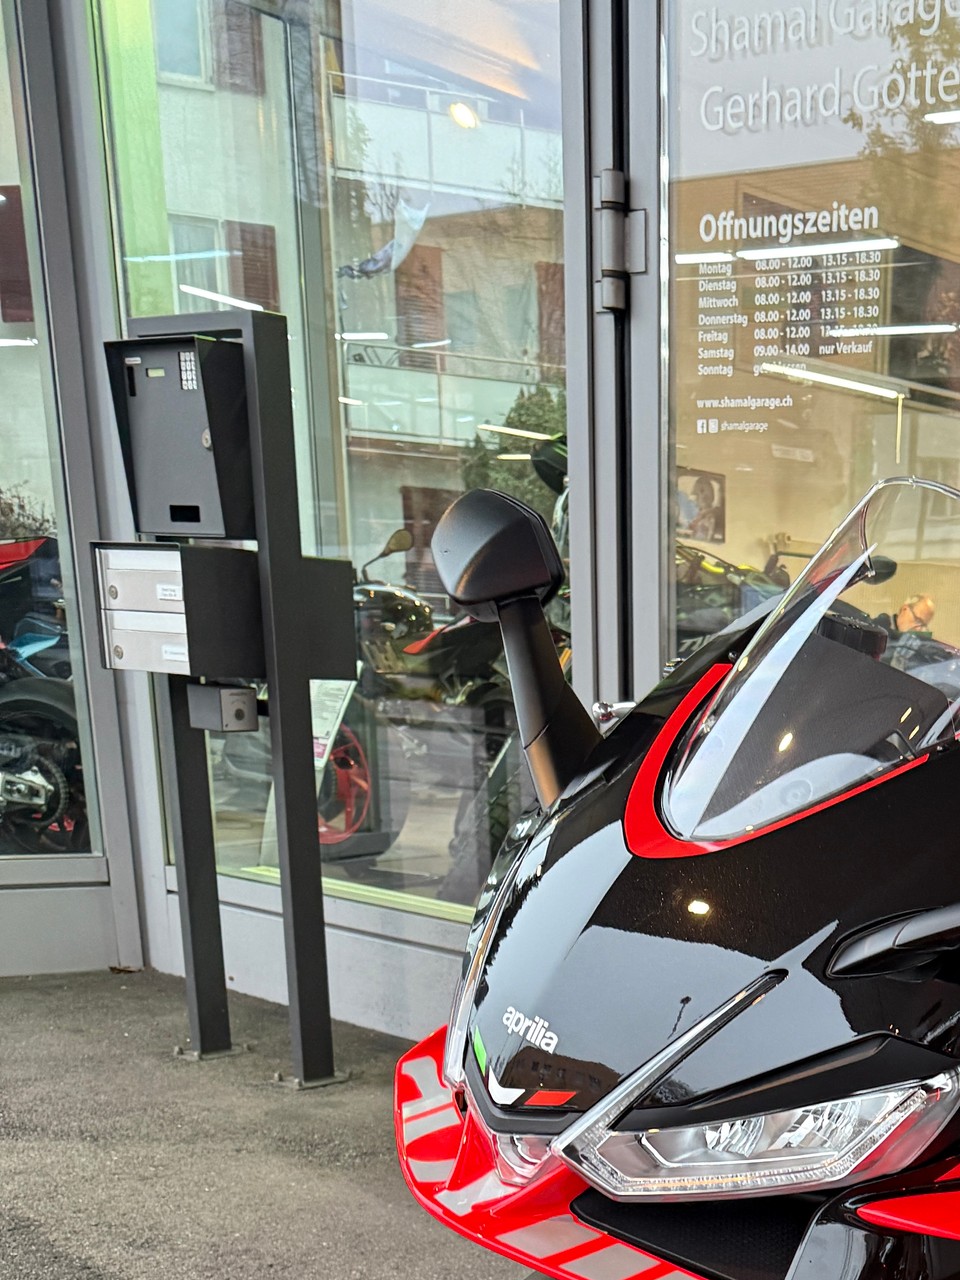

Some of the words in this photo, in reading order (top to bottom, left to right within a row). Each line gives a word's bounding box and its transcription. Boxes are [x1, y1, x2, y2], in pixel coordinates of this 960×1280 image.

[690, 0, 817, 57] Shamal
[700, 67, 842, 131] Gerhard
[852, 59, 960, 113] Götte
[699, 263, 732, 276] Montag
[755, 259, 780, 271] 08.00
[787, 257, 812, 268] 12.00
[822, 254, 847, 266] 13.15
[855, 251, 881, 263] 18.30
[699, 280, 737, 293] Dienstag
[755, 276, 780, 288] 08.00
[787, 274, 812, 286] 12.00
[822, 272, 847, 284] 13.15
[855, 269, 880, 282] 18.30
[698, 295, 739, 308] Mittwoch
[754, 294, 780, 306] 08.00
[786, 291, 812, 303] 12.00
[821, 290, 846, 302] 13.15
[854, 287, 880, 300] 18.30
[698, 313, 749, 327] Donnerstag
[754, 311, 779, 323] 08.00
[786, 309, 810, 321] 12.00
[820, 307, 846, 319] 13.15
[853, 306, 879, 318] 18.30
[698, 330, 728, 344] Freitag
[754, 328, 779, 340] 08.00
[785, 327, 810, 338] 12.00
[698, 347, 735, 360] Samstag
[753, 345, 778, 357] 09.00
[785, 344, 810, 355] 14.00
[819, 345, 835, 355] nur
[836, 341, 873, 354] Verkauf
[698, 364, 733, 377] Sonntag
[697, 395, 793, 410] www.shamalgarage.ch
[502, 1006, 558, 1054] aprilia
